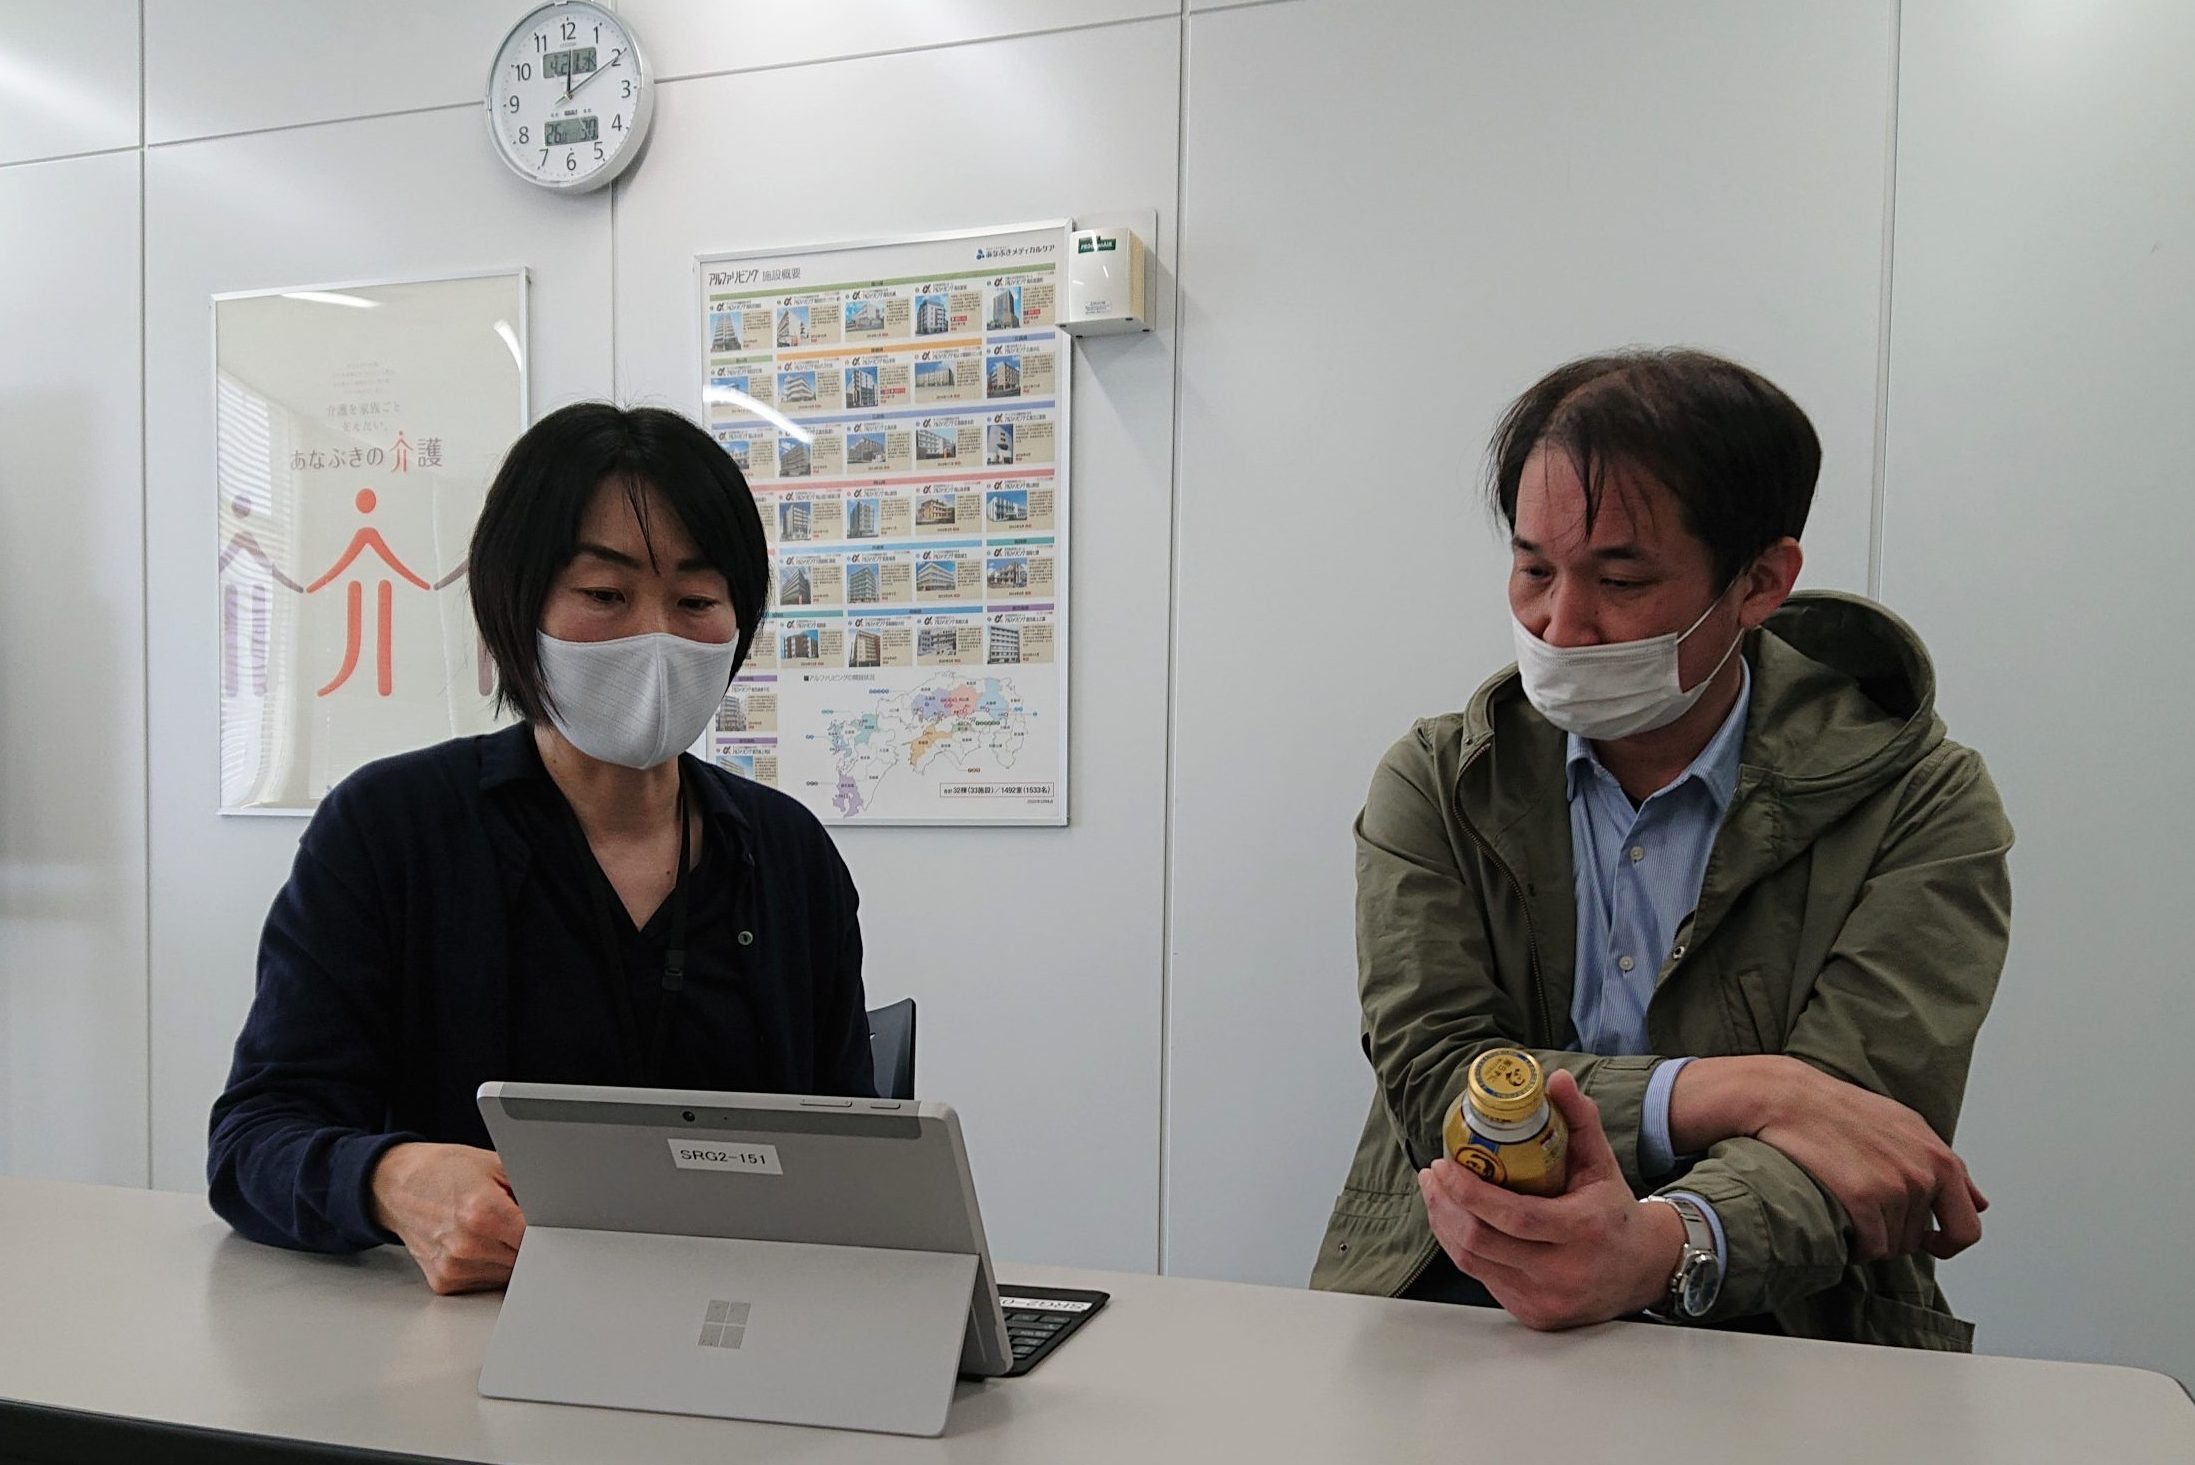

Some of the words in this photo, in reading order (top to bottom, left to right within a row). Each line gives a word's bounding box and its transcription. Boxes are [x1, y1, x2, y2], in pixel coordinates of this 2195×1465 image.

[560, 22, 576, 41] 12
[535, 34, 547, 53] 11
[611, 48, 622, 67] 2
[515, 62, 531, 81] 10
[621, 79, 631, 99] 3
[509, 95, 520, 113] 9
[611, 113, 622, 132] 4
[518, 126, 530, 145] 8
[539, 148, 549, 167] 7
[593, 141, 604, 160] 5
[566, 152, 577, 171] 6
[708, 268, 759, 287] アルファリビング
[762, 267, 801, 282] 施設概要
[290, 430, 443, 473] あなぶきの介護
[680, 1149, 766, 1165] SRG2-151
